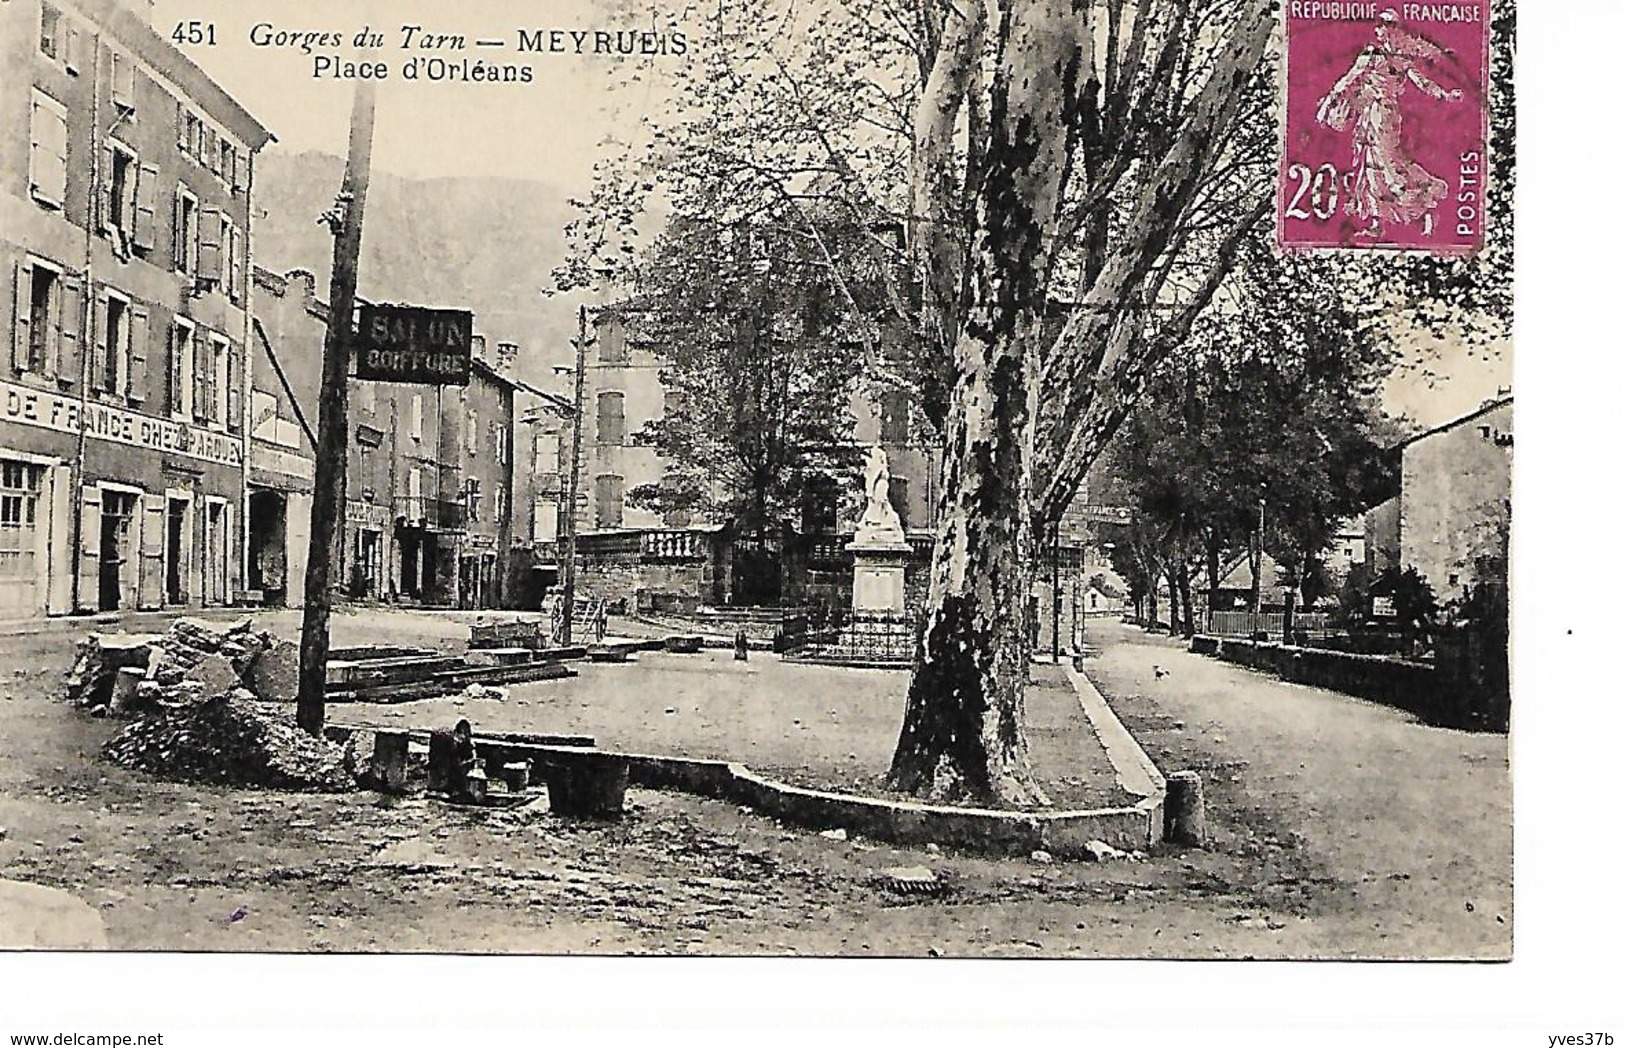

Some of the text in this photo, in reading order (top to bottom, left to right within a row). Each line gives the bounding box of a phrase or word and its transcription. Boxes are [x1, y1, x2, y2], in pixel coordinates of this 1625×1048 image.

[1402, 4, 1480, 23] FRANÇAISE
[1456, 151, 1479, 236] POSTES
[8, 390, 38, 420] DE
[51, 399, 134, 441] FRANCE
